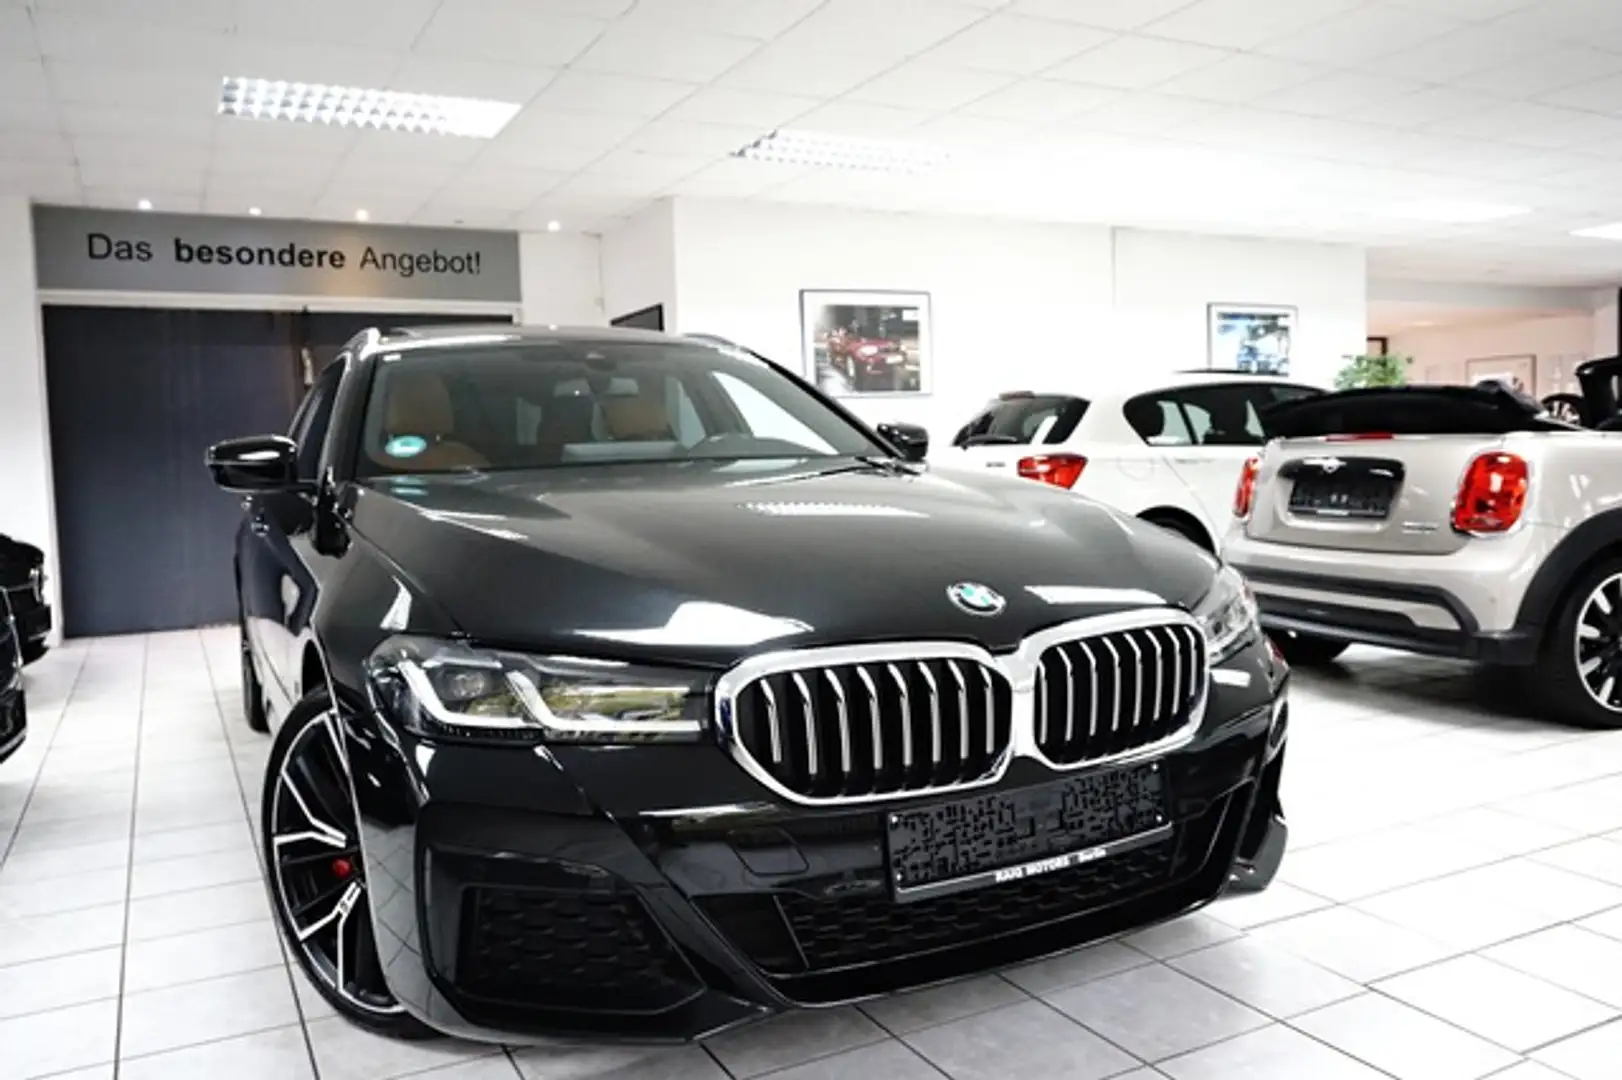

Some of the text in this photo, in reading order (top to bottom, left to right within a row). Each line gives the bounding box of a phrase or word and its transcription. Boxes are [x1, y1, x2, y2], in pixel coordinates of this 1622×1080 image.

[87, 232, 481, 278] Das besondere Angebot!
